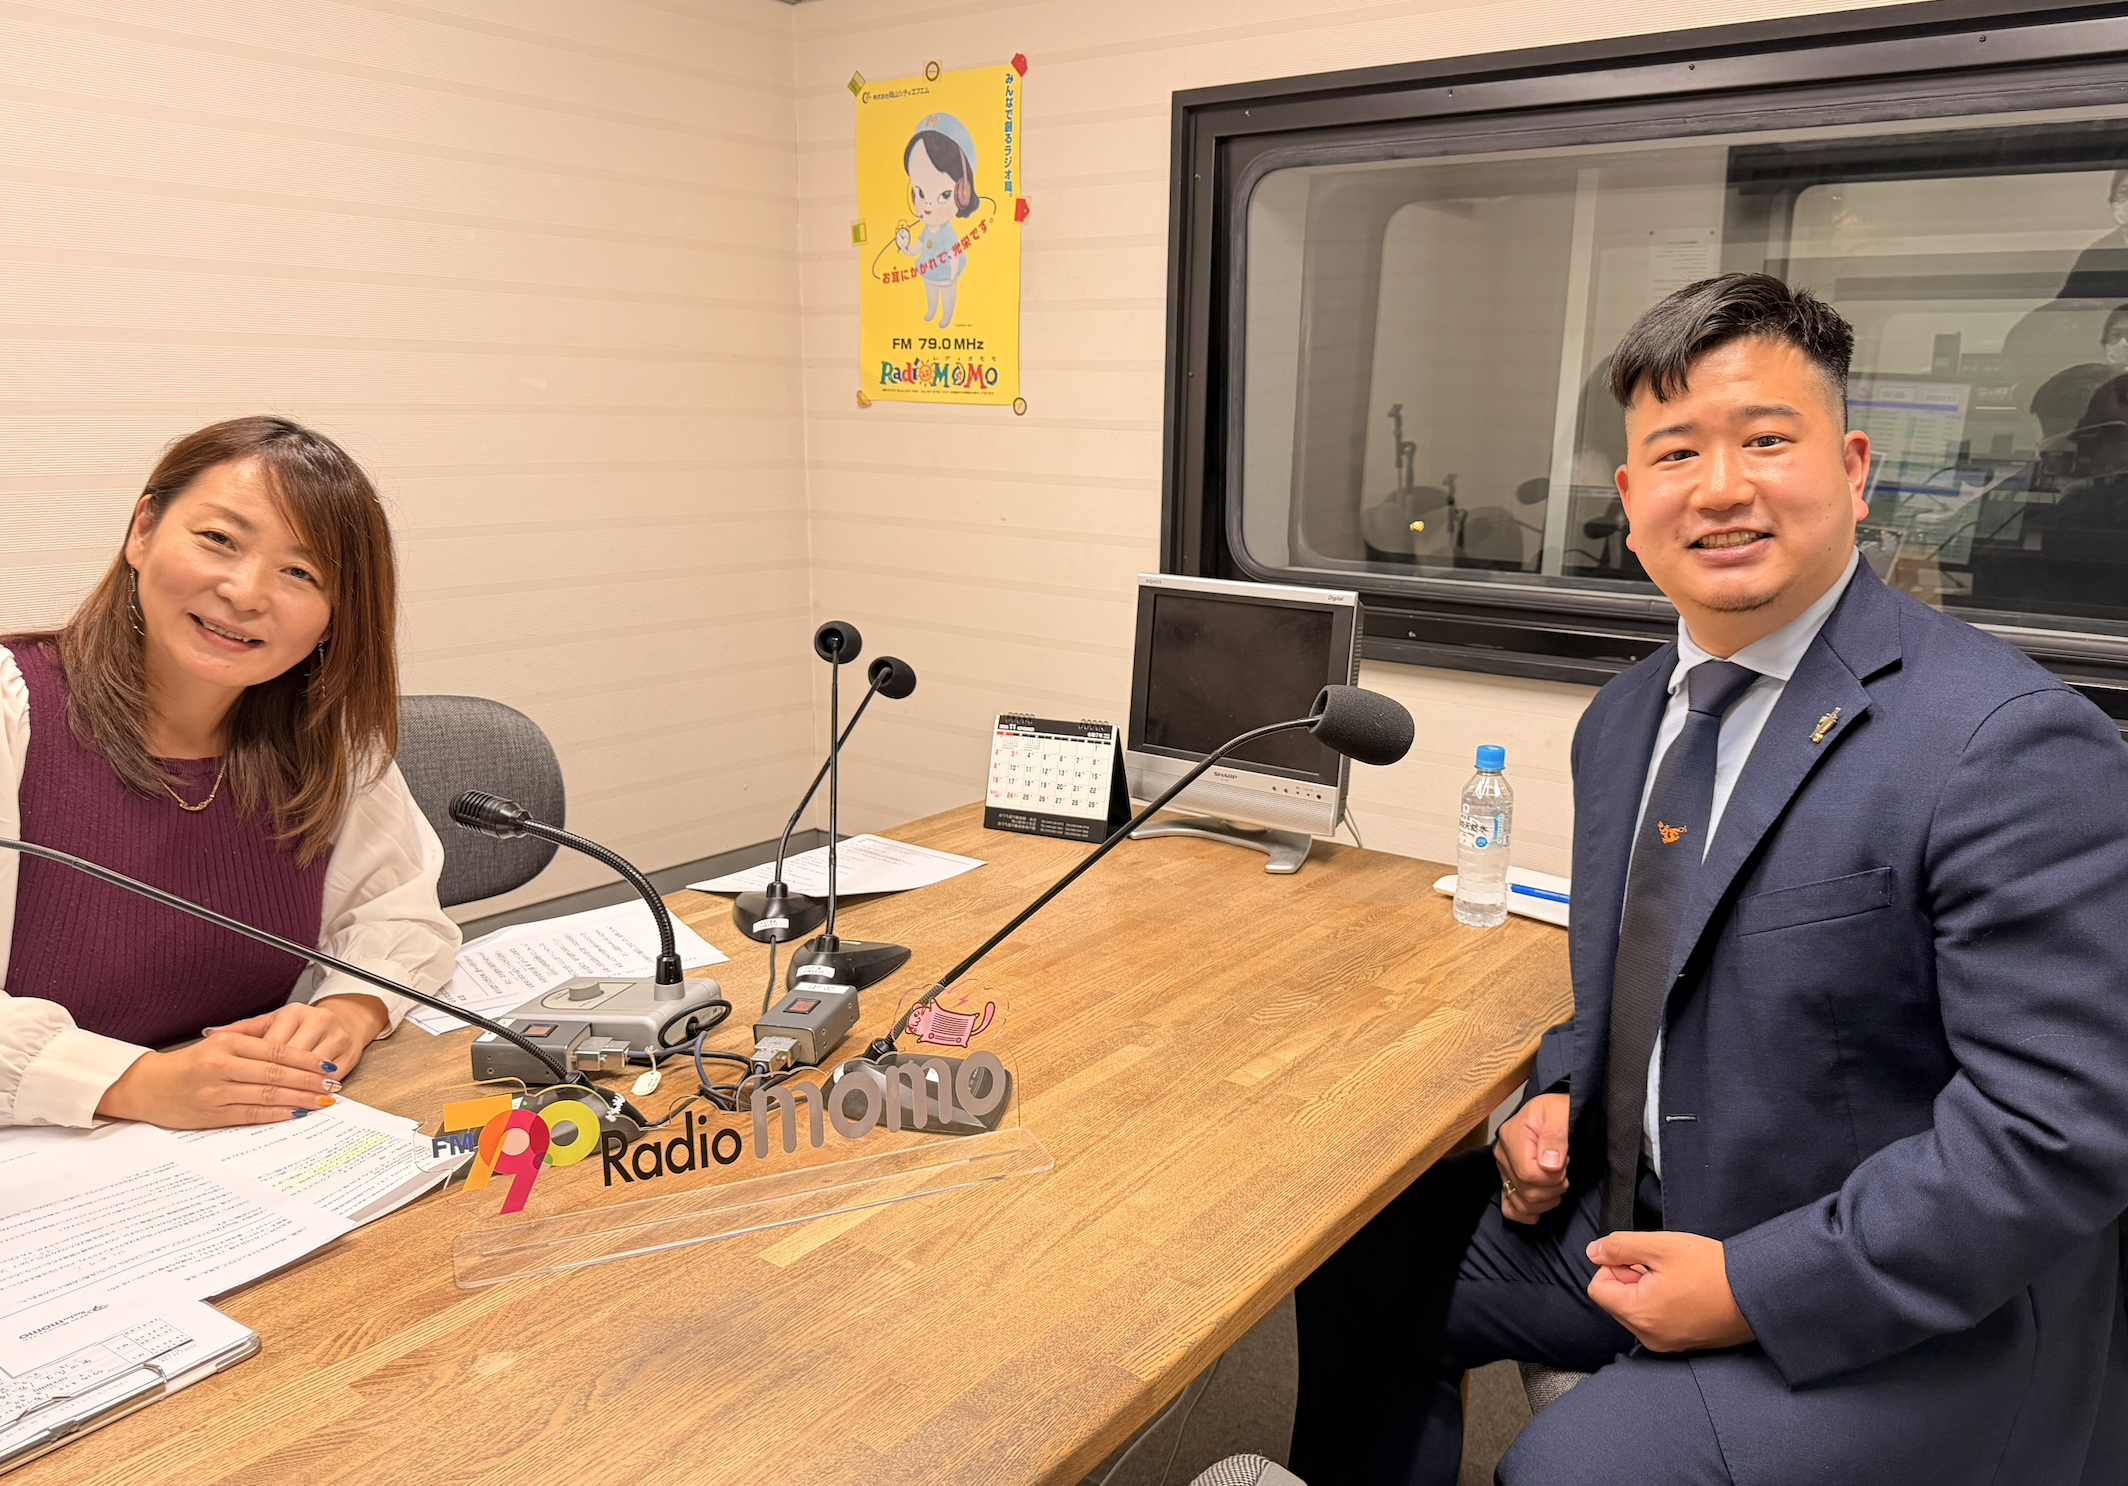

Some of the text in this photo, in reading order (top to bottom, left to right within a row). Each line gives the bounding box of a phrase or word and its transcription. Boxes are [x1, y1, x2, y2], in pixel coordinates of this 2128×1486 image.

[1004, 73, 1014, 198] みんなで創るラジオ局。
[882, 217, 994, 285] お耳にかかれて、光栄です。
[892, 338, 984, 350] FM 79.0 MHz
[1327, 594, 1344, 602] Digital
[1213, 771, 1238, 779] SHARP
[432, 1132, 476, 1159] FM
[602, 1110, 743, 1187] Radio
[752, 1051, 1005, 1159] momo
